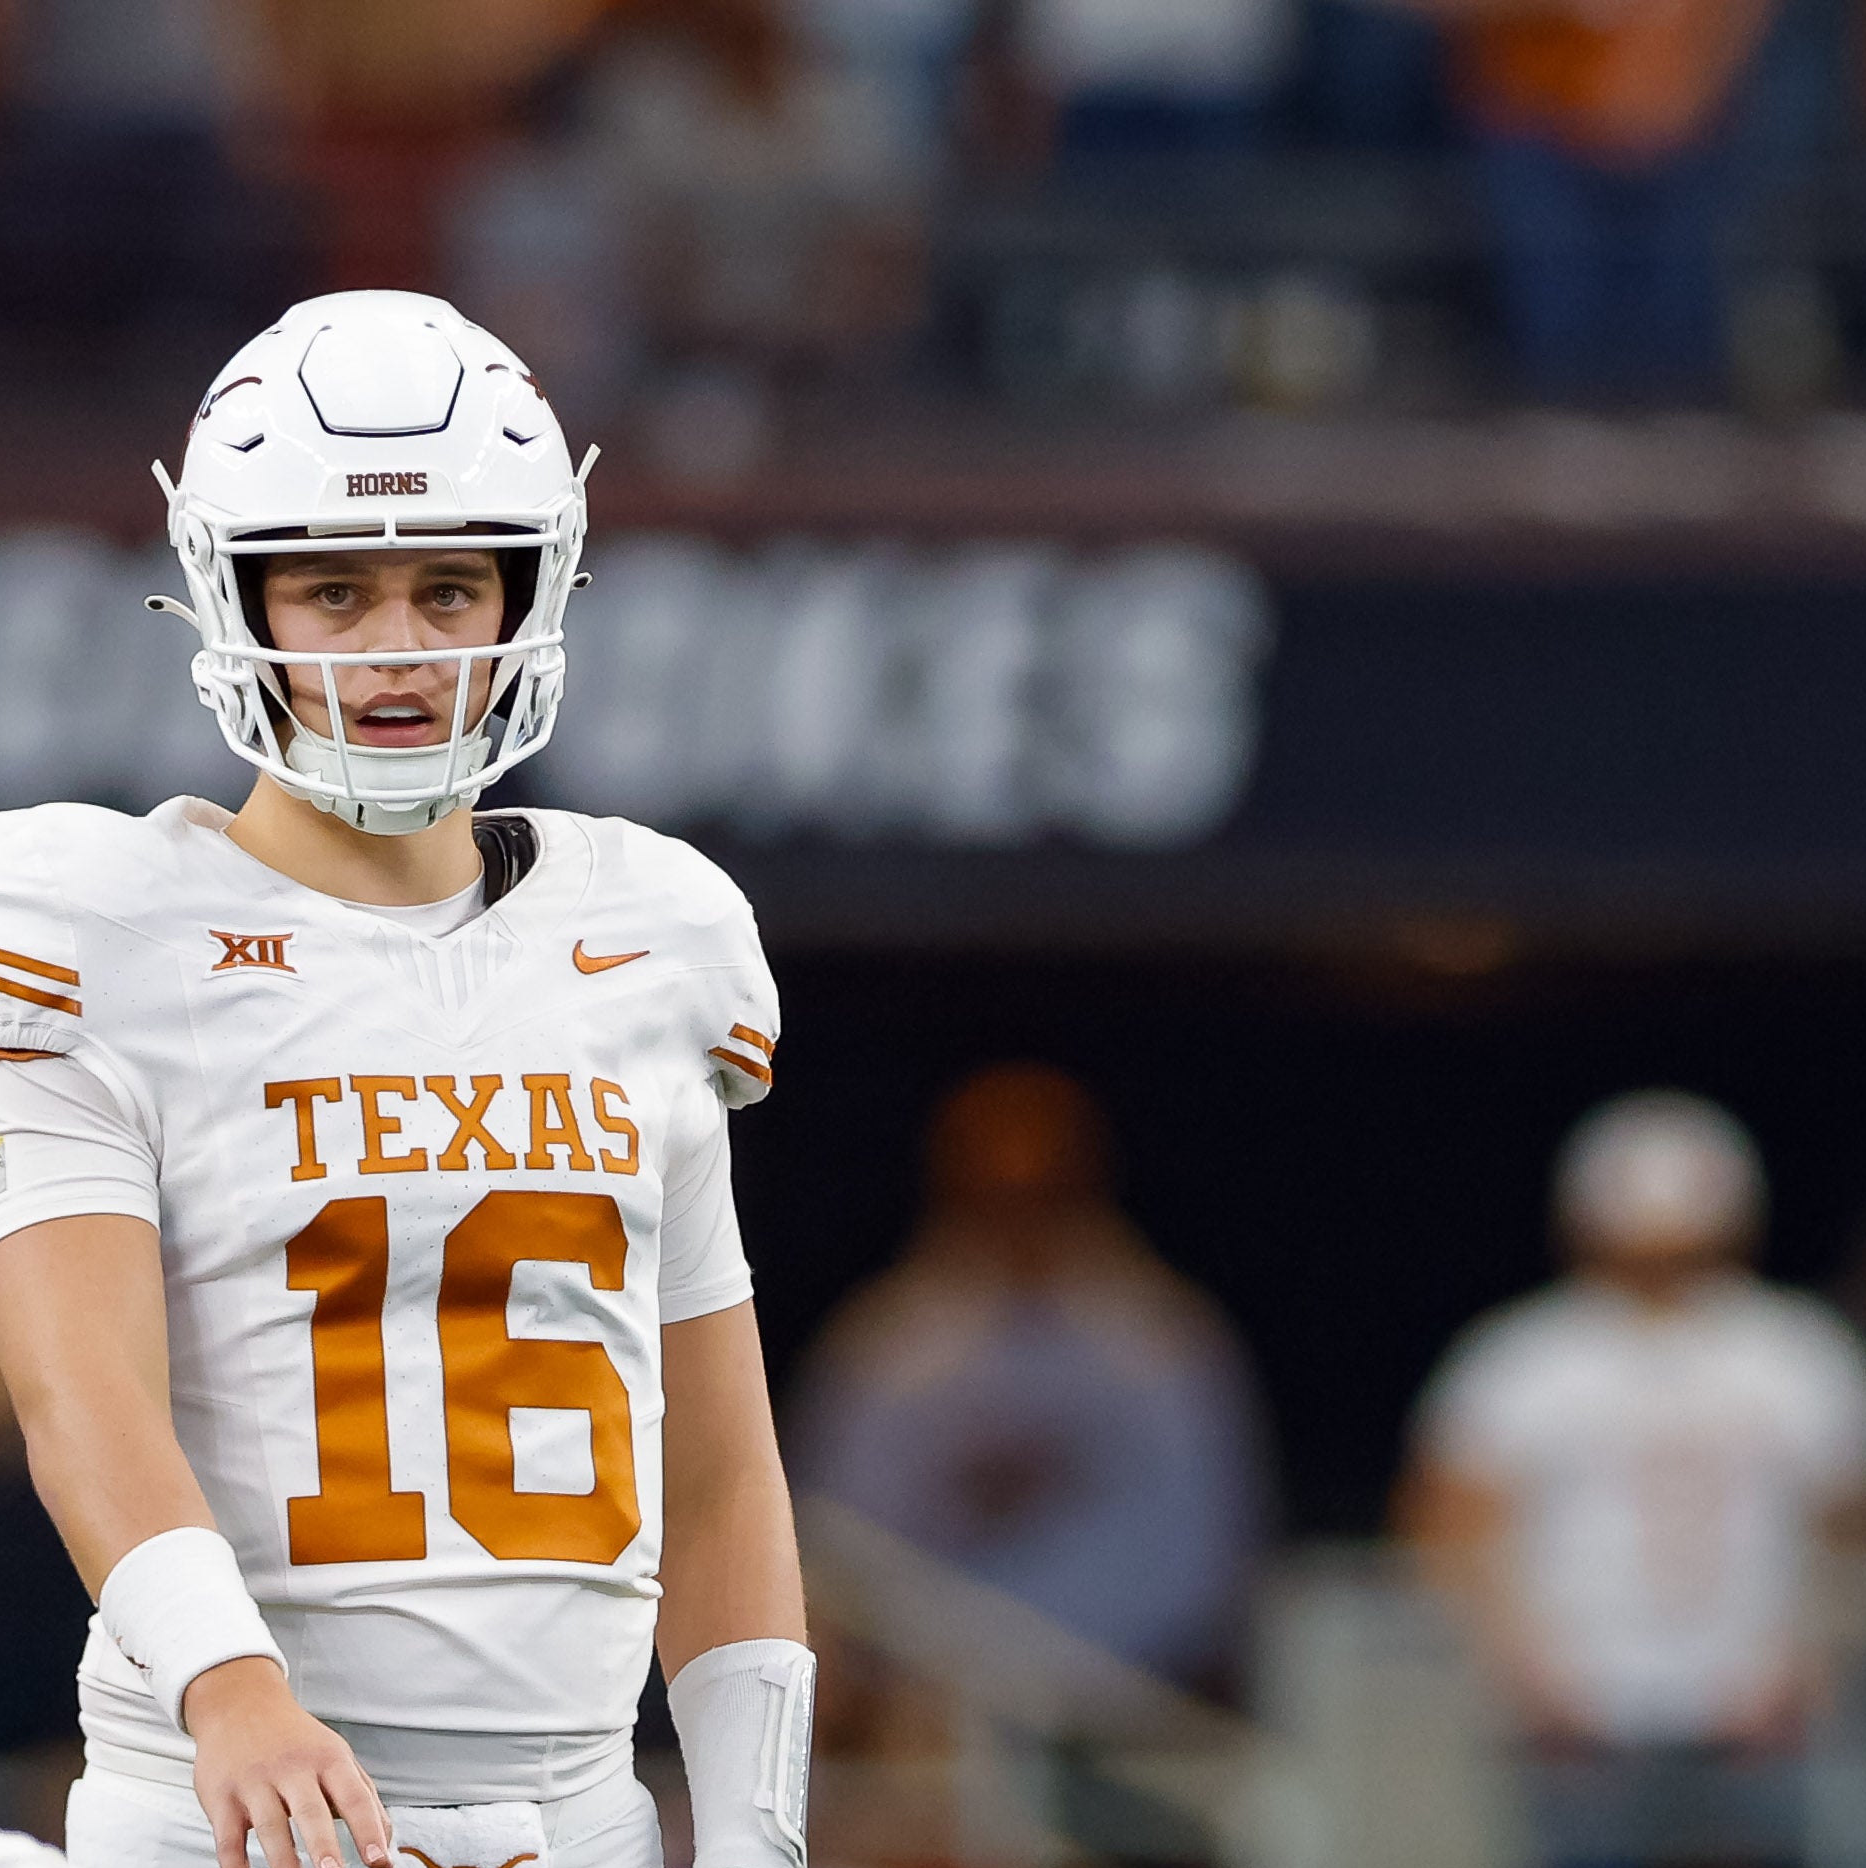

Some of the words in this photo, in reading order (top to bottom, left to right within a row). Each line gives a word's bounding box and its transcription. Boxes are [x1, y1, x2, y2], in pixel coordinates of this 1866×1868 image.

[346, 472, 427, 497] HORNS
[208, 929, 297, 974] XII
[264, 1073, 639, 1182] TEXAS
[285, 1190, 642, 1565] 16
